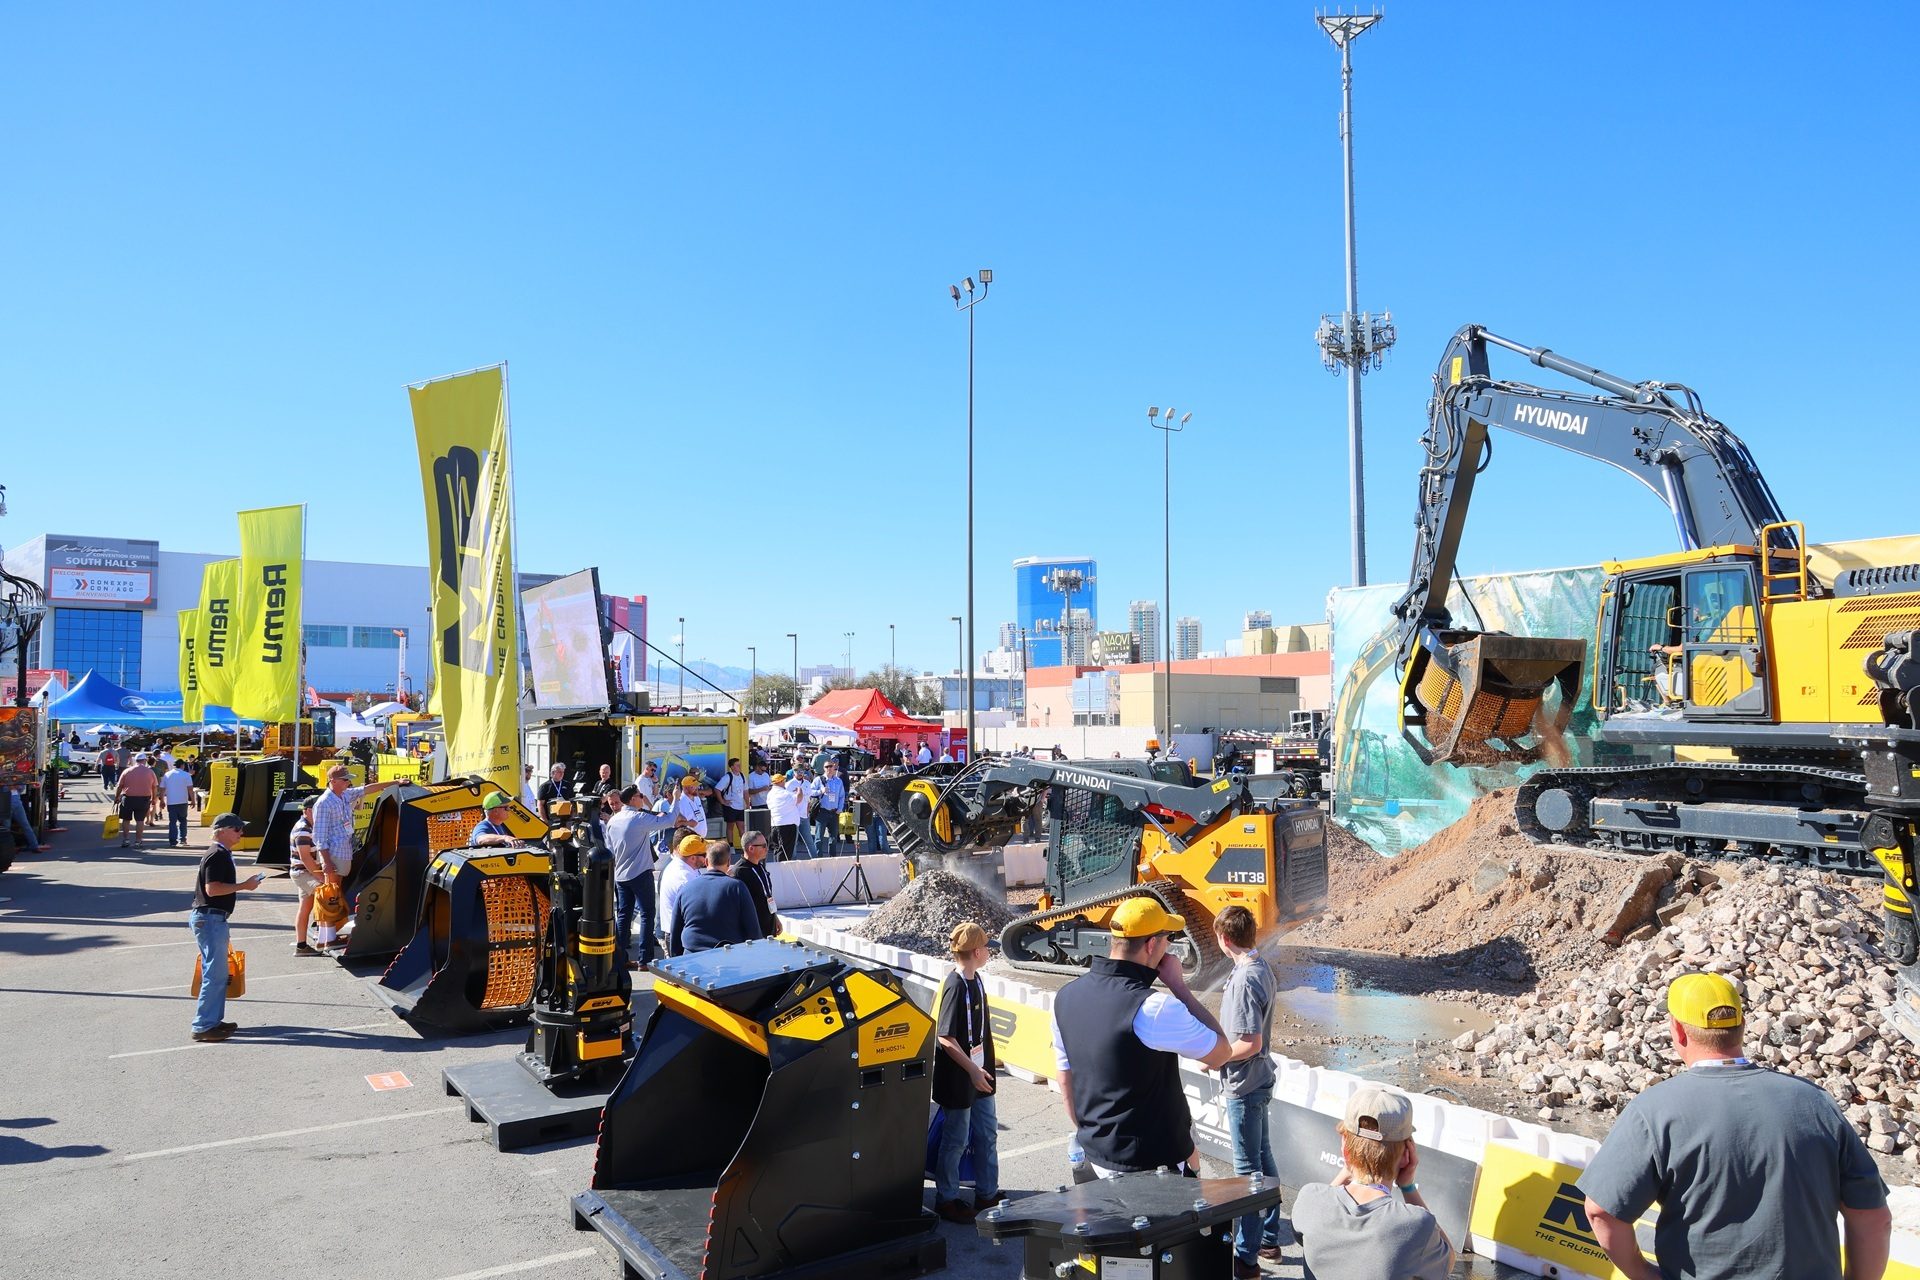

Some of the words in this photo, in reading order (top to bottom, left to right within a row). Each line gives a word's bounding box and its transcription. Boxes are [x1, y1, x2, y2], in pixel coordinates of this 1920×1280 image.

[1513, 403, 1589, 435] HYUNDAI
[65, 556, 102, 567] SOUTH
[105, 559, 138, 568] HALLS
[90, 579, 135, 587] CONEXPO
[1103, 633, 1130, 646] NAQVI
[498, 648, 507, 678] THE
[272, 771, 280, 797] Remu
[1055, 769, 1111, 791] HYUNDAI
[508, 804, 531, 823] MB
[1294, 816, 1319, 833] HYUNDAI
[1227, 871, 1265, 883] HT38
[774, 1005, 807, 1028] MB
[987, 1005, 1017, 1038] B
[873, 1022, 911, 1039] MB
[875, 1045, 906, 1055] MB-HDS314
[1535, 1230, 1556, 1243] THE
[1559, 1239, 1612, 1263] CRUSHIN
